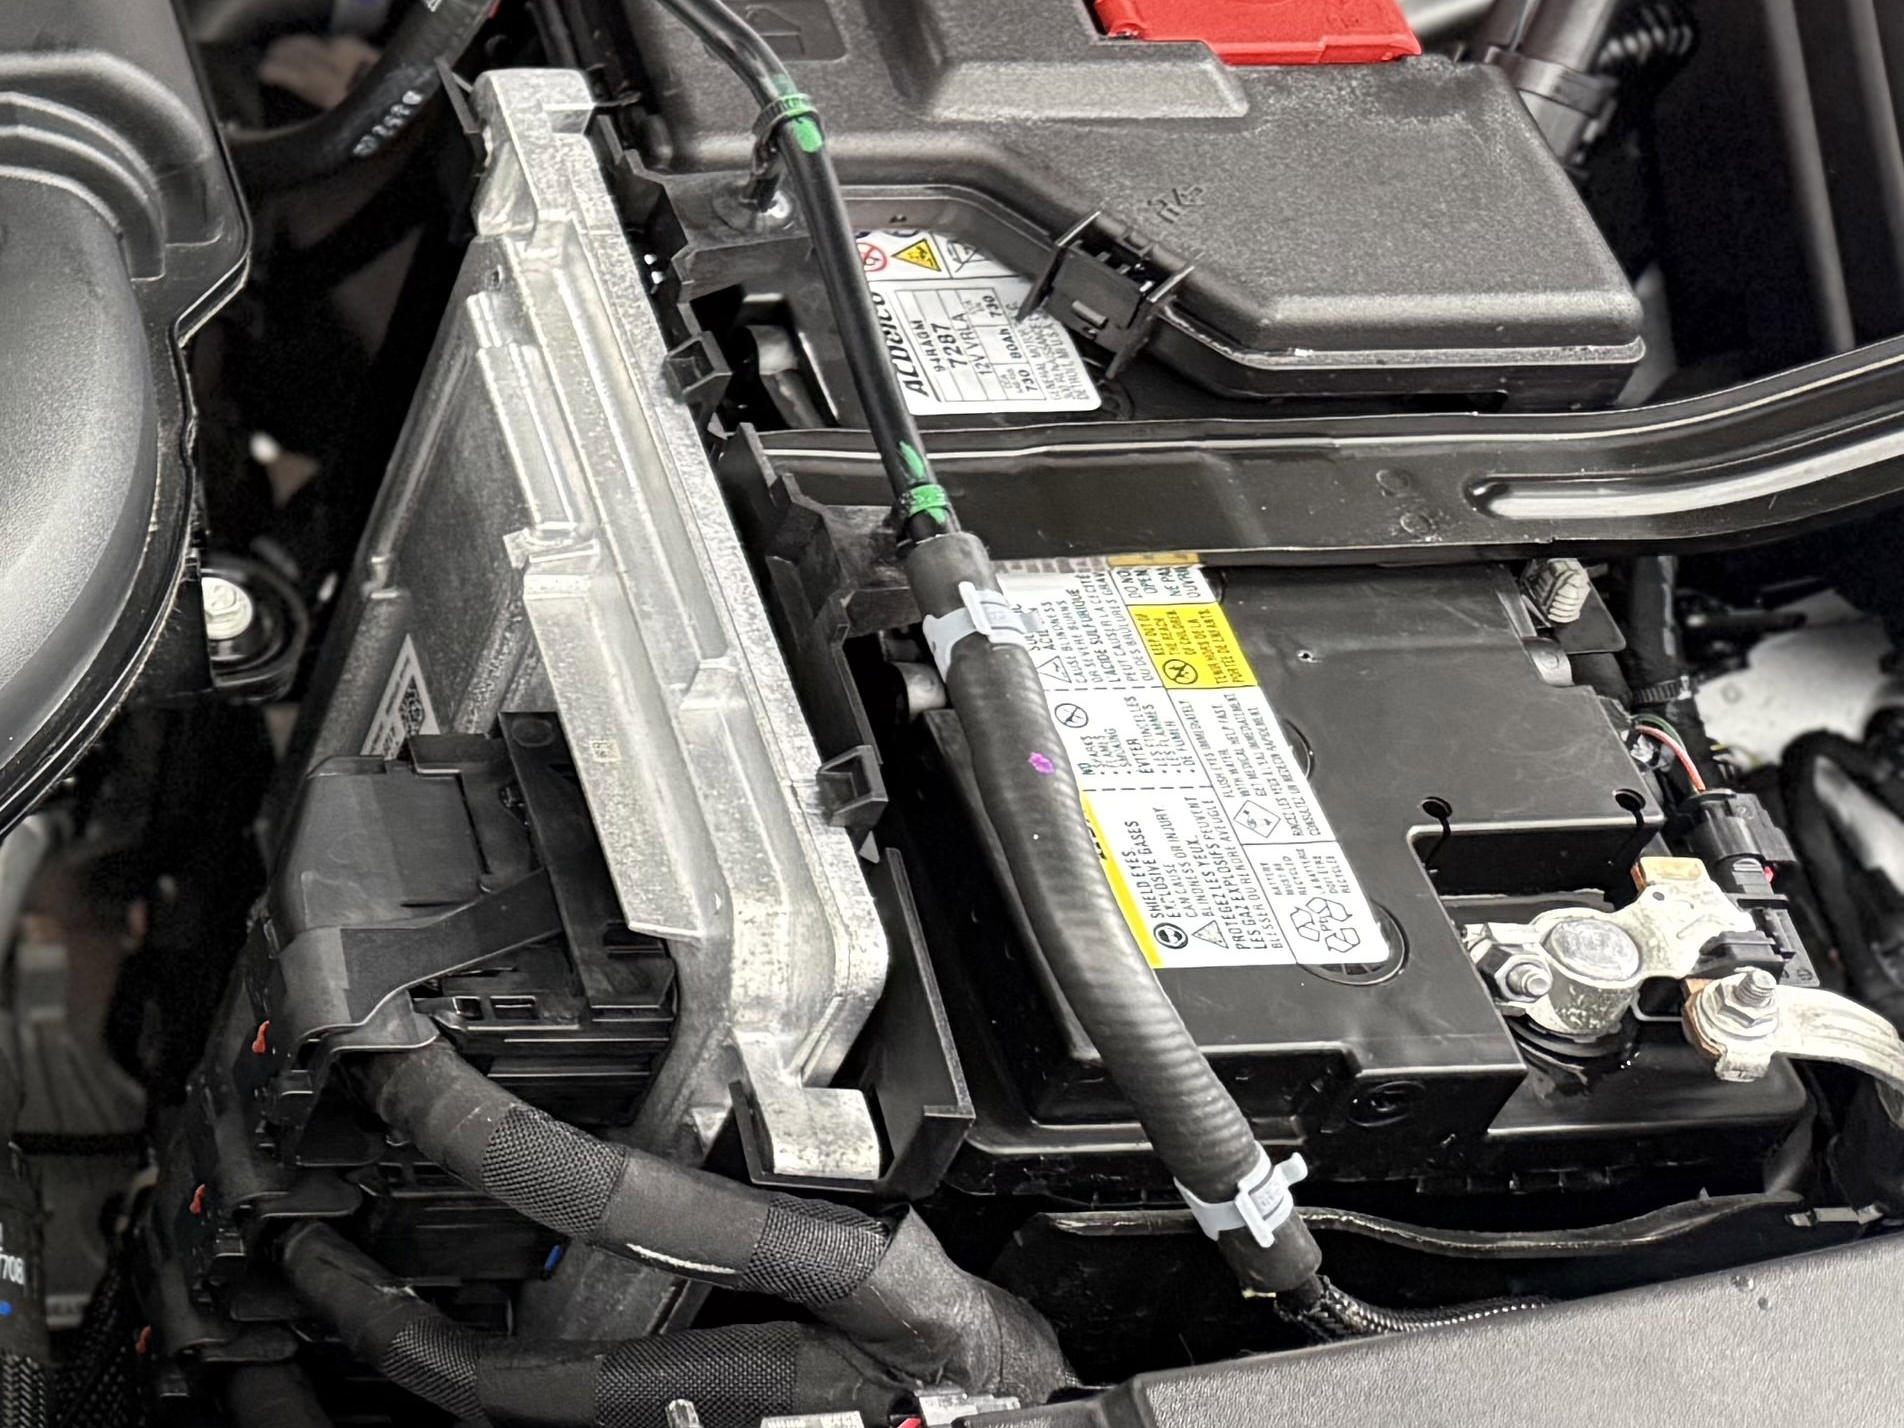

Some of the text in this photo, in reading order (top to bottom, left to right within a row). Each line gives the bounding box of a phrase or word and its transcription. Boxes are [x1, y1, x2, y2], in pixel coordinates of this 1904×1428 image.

[981, 294, 1002, 317] 730
[930, 322, 967, 368] 7287
[968, 353, 992, 375] 12V
[1017, 368, 1037, 391] 730
[1123, 820, 1152, 854] GASES
[1169, 844, 1187, 859] OR
[1162, 863, 1198, 918] CAN CAUSE
[1178, 861, 1214, 917] BLINDNESS
[1183, 796, 1268, 949] LES GAZ EXPLOSIFS PEUVENT
[1200, 870, 1222, 890] LES
[1201, 799, 1283, 949] BLESSER OU RENDRE AVEUGLE
[1135, 880, 1164, 918] SHIELD
